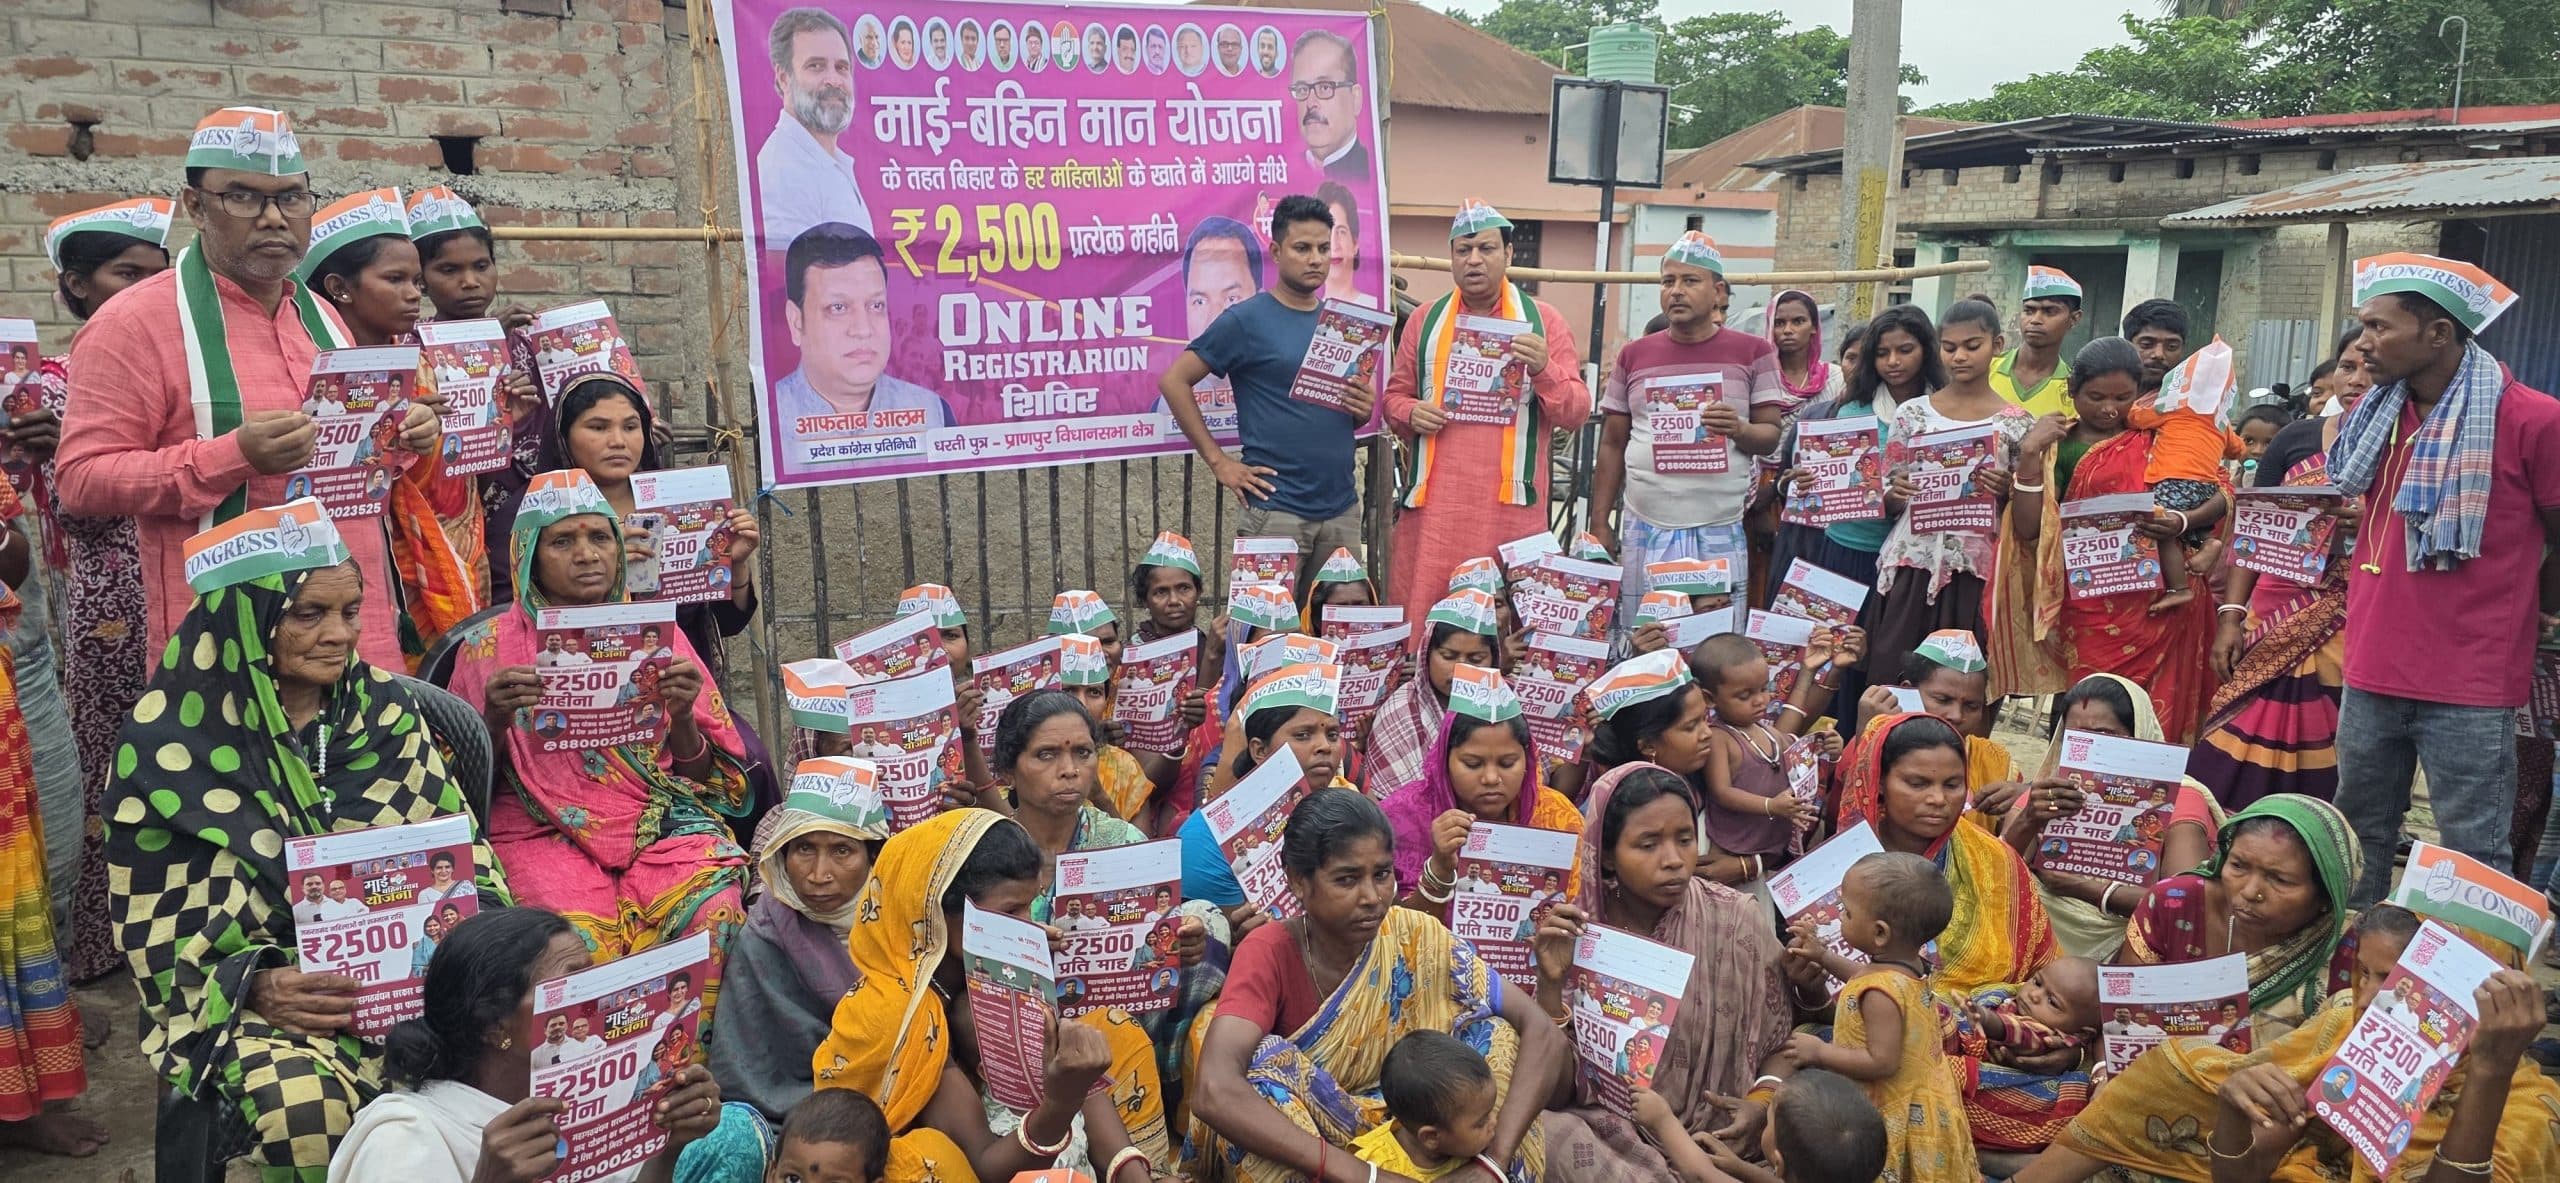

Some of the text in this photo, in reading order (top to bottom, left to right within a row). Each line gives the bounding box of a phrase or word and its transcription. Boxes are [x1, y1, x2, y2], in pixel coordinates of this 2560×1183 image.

[871, 77, 1282, 155] माई-बहिन मान योजना
[880, 154, 1288, 190] के तहत बिहार के हर महिलाओं के खाते में आएंगे सीधे
[1068, 213, 1179, 258] प्रत्येक महीने
[2378, 266, 2475, 299] CONGRESS
[1311, 340, 1352, 364] ₹2500
[1450, 361, 1493, 378] ₹2500
[1000, 385, 1099, 419] शिविर
[795, 407, 926, 435] आफताब आलम
[1455, 412, 1511, 424] 8800023525
[1651, 416, 1693, 430] ₹2500
[315, 423, 361, 447] 2500
[934, 432, 967, 454] धरती
[971, 436, 989, 454] पुत्र
[1004, 428, 1052, 452] प्राणपुर
[1055, 424, 1128, 445] विधानसभा
[1131, 421, 1155, 443] क्षेत्र
[809, 441, 836, 460] प्रदेश
[838, 438, 873, 457] कांग्रेस
[454, 457, 506, 476] 8800023525
[1667, 461, 1726, 470] 8800023525
[1819, 510, 1879, 522] 8800023525
[1924, 517, 1992, 529] 8800023525
[2239, 510, 2297, 530] ₹2500
[2239, 523, 2291, 543] प्रति माह
[186, 531, 278, 580] CONGRESS
[2066, 537, 2119, 555] ₹2500
[2094, 552, 2118, 563] माह
[1655, 572, 1706, 584] CONGRESS
[2246, 561, 2316, 584] 8800023525
[1531, 601, 1579, 621] ₹2500
[1516, 682, 1565, 705] ₹2500
[559, 729, 654, 749] 8800023525
[876, 758, 928, 782] 2500
[900, 782, 926, 798] माह
[2050, 822, 2112, 840] प्रति माह
[1245, 851, 1283, 895] ₹250
[2056, 862, 2144, 884] 8800023525
[365, 890, 413, 906] योजना
[1457, 900, 1520, 922] ₹2500
[1456, 920, 1513, 939] प्रति माह
[301, 921, 408, 964] ₹2500
[1058, 957, 1091, 974] प्रति
[1096, 957, 1128, 971] माह
[604, 1018, 649, 1040] योजना
[1576, 1015, 1617, 1053] ₹2500
[2360, 1016, 2422, 1077] ₹2500
[2343, 1042, 2403, 1097] प्रति माह
[2329, 1111, 2389, 1174] 8800023525
[557, 1130, 672, 1183] 880002352
